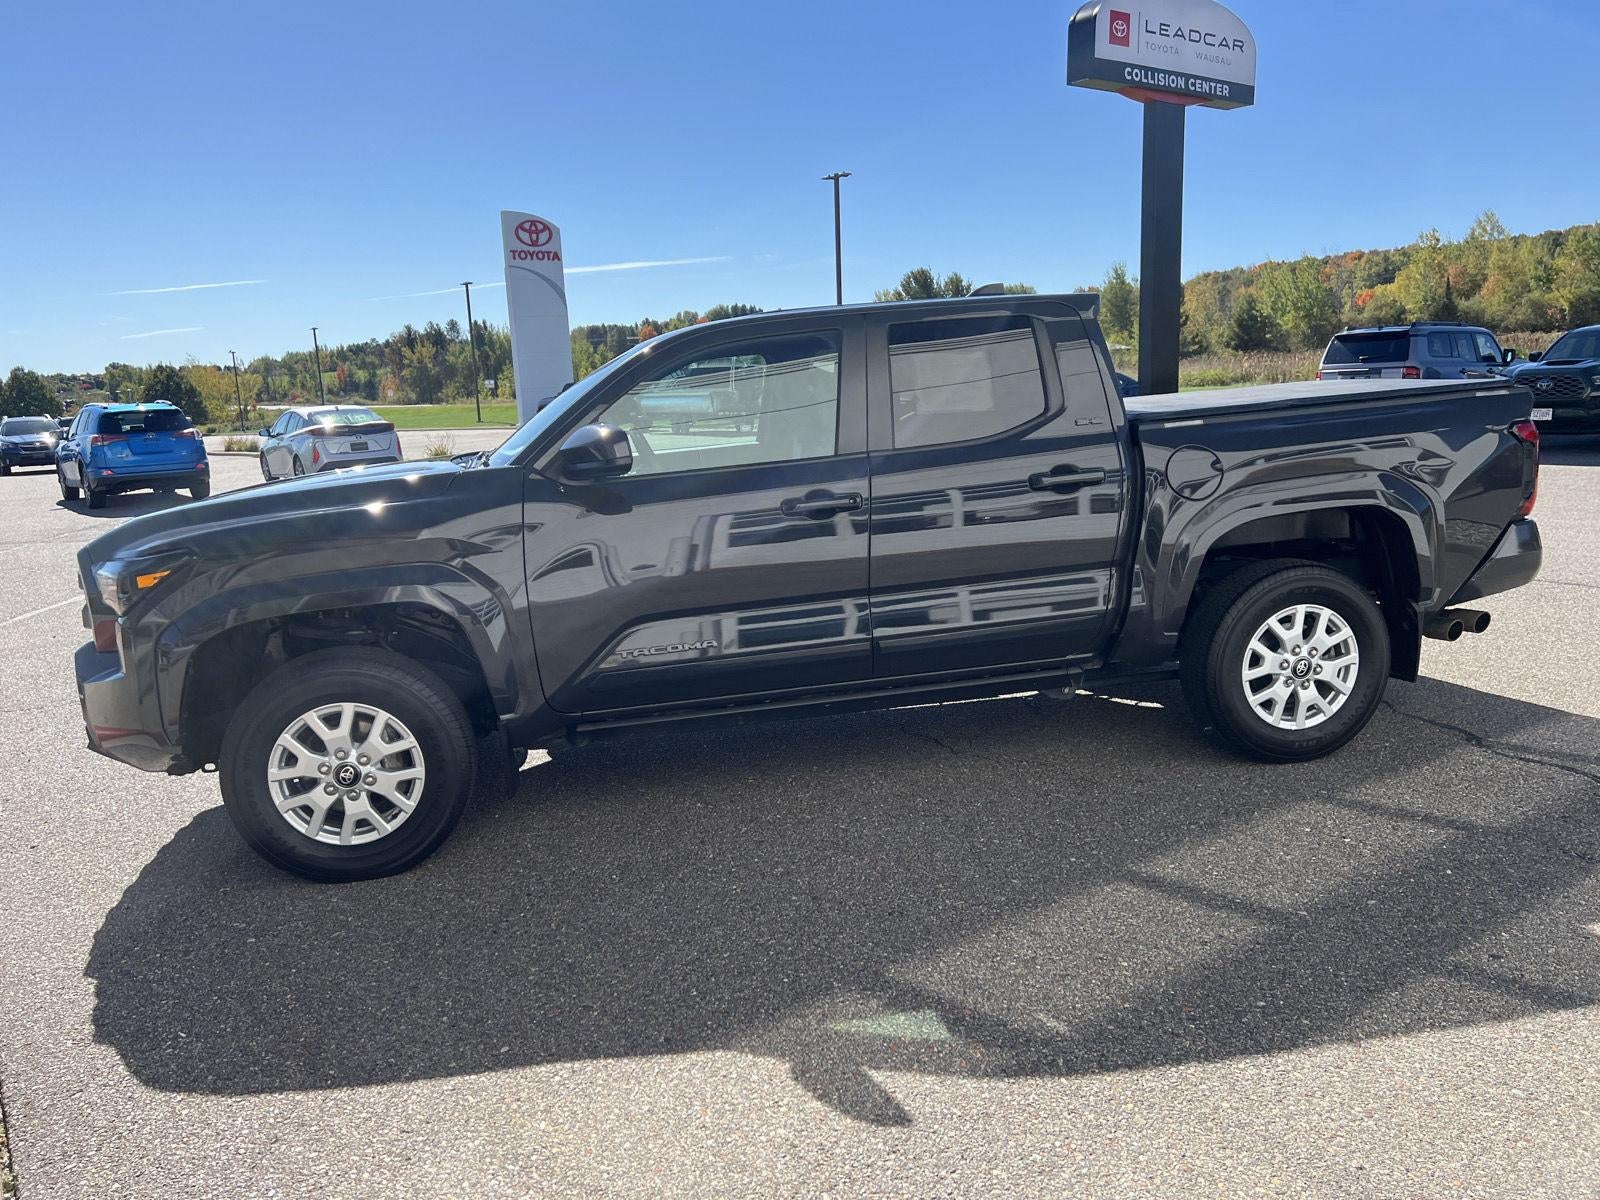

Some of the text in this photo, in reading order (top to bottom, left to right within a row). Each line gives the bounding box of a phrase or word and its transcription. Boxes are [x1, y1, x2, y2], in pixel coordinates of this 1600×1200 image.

[1145, 19, 1245, 53] LEADCAR
[1145, 41, 1232, 66] TOYOTA WAUSAU
[1124, 67, 1230, 97] COLLISION CENTER
[509, 249, 561, 261] TOYOTA
[616, 640, 718, 659] TACOMA
